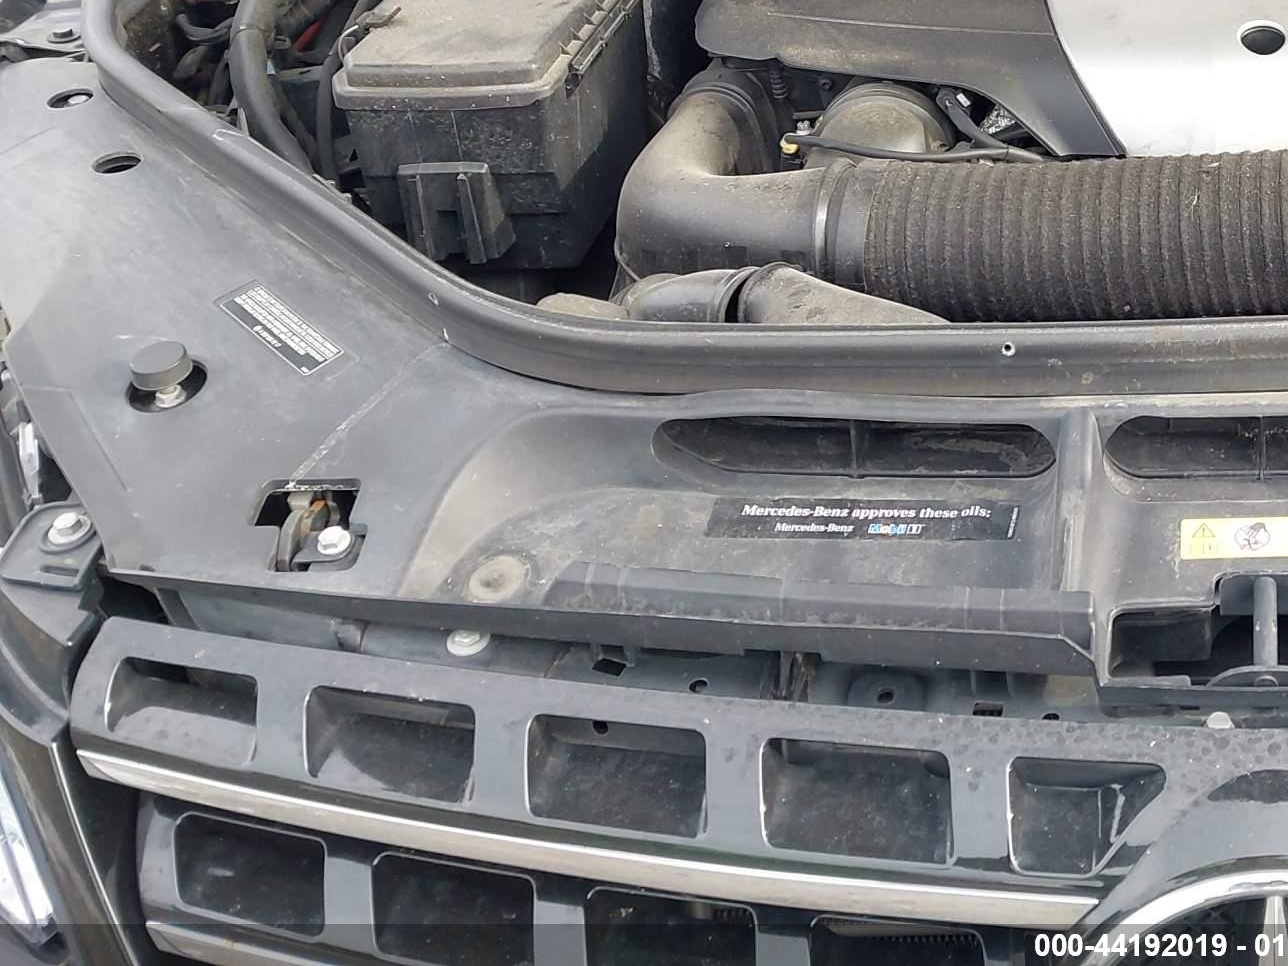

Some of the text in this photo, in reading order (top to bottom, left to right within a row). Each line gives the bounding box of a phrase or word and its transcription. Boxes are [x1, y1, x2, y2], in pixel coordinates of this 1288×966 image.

[741, 504, 849, 518] Mercedes-Benz
[851, 508, 917, 520] approves
[919, 506, 958, 519] these
[774, 522, 855, 534] Mercedes-Benz
